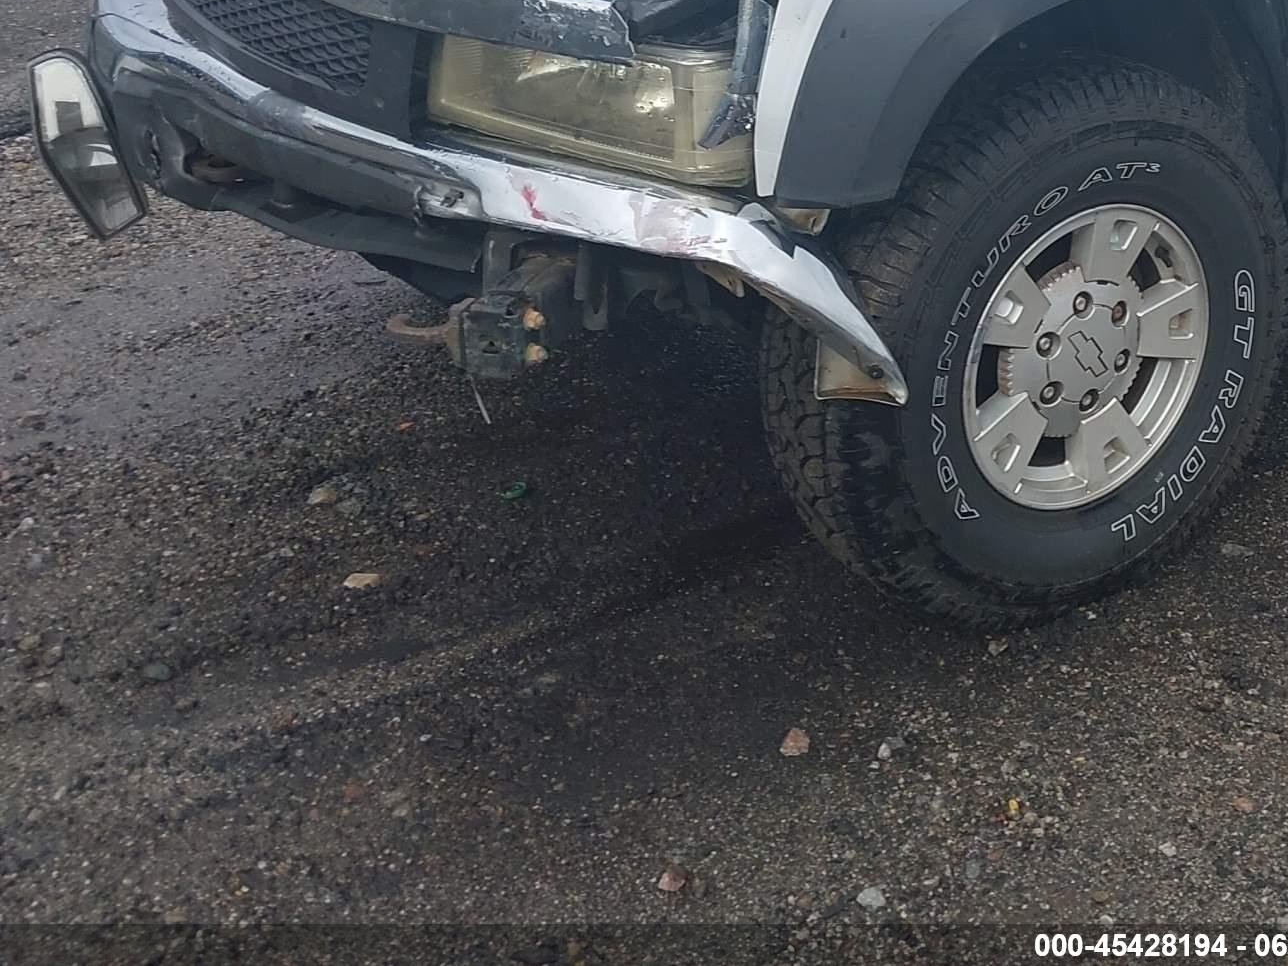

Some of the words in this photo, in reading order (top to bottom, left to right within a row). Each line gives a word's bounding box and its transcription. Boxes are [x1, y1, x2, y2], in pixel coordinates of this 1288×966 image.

[930, 185, 1069, 521] ADVENTURO
[1232, 268, 1255, 360] GT
[1110, 369, 1245, 543] RADIAL
